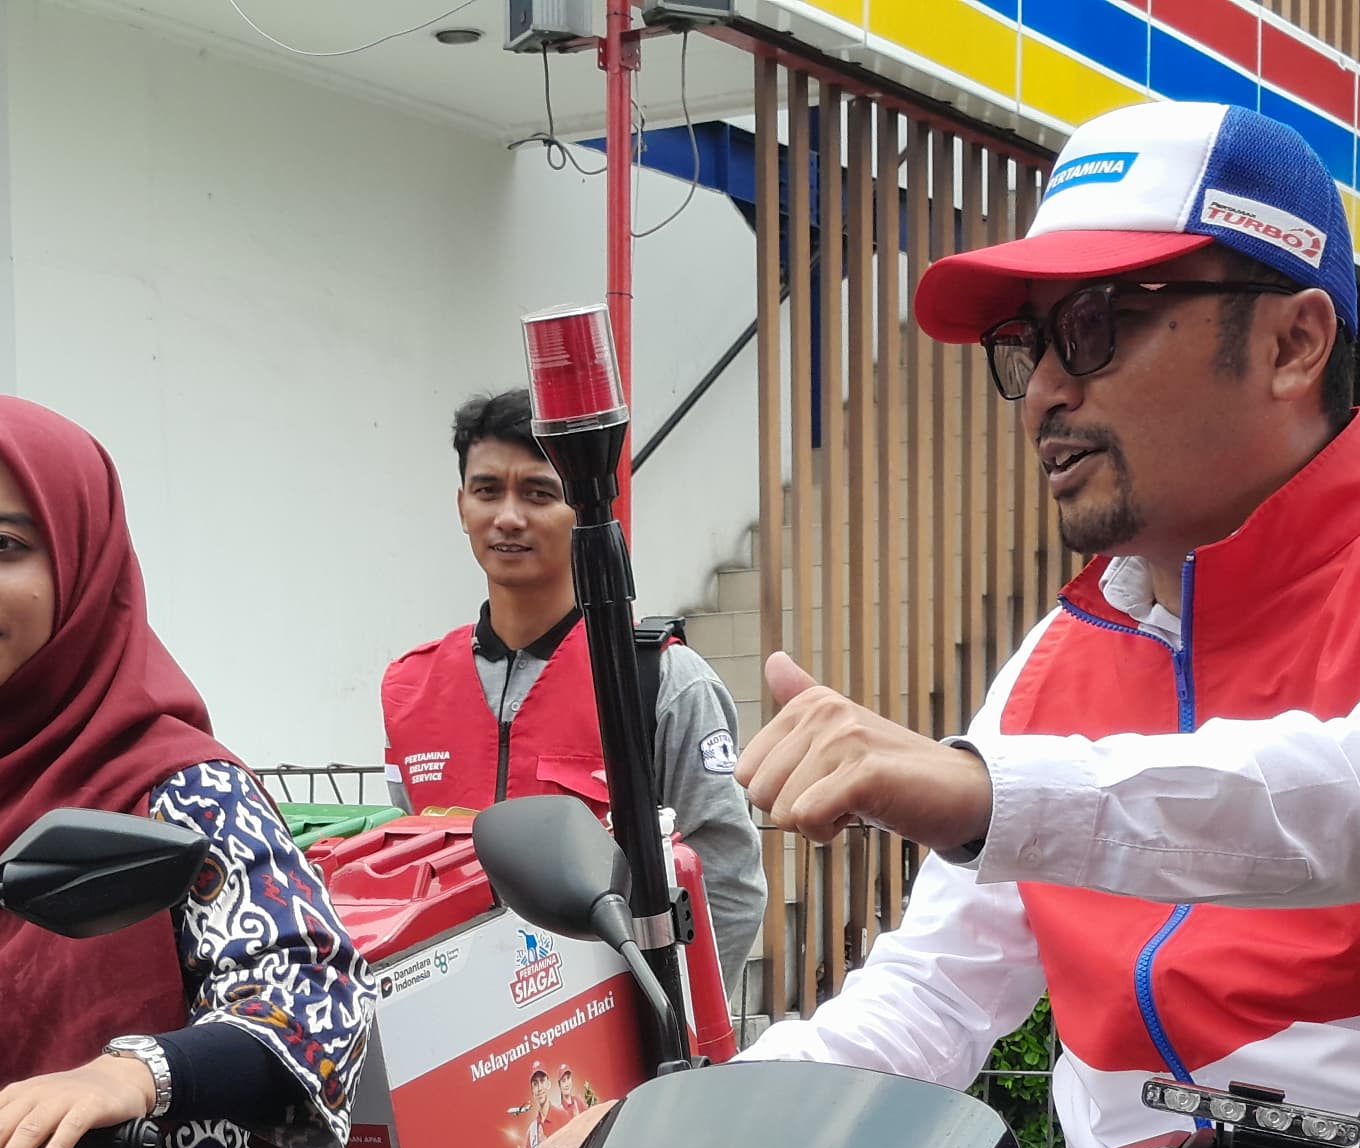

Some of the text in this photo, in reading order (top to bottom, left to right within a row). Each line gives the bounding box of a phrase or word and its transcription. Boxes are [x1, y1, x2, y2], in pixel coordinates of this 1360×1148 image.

[1207, 207, 1303, 248] TURBO
[404, 751, 451, 765] PERTAMINA
[409, 762, 446, 774] DELIVERY
[411, 772, 443, 784] SERVICE
[393, 958, 432, 981] Danantara
[519, 954, 558, 980] PERTAMINA
[395, 969, 431, 992] Indonesia
[515, 967, 558, 1003] SIAGA
[470, 991, 615, 1082] Melayani Sepenuh Hati
